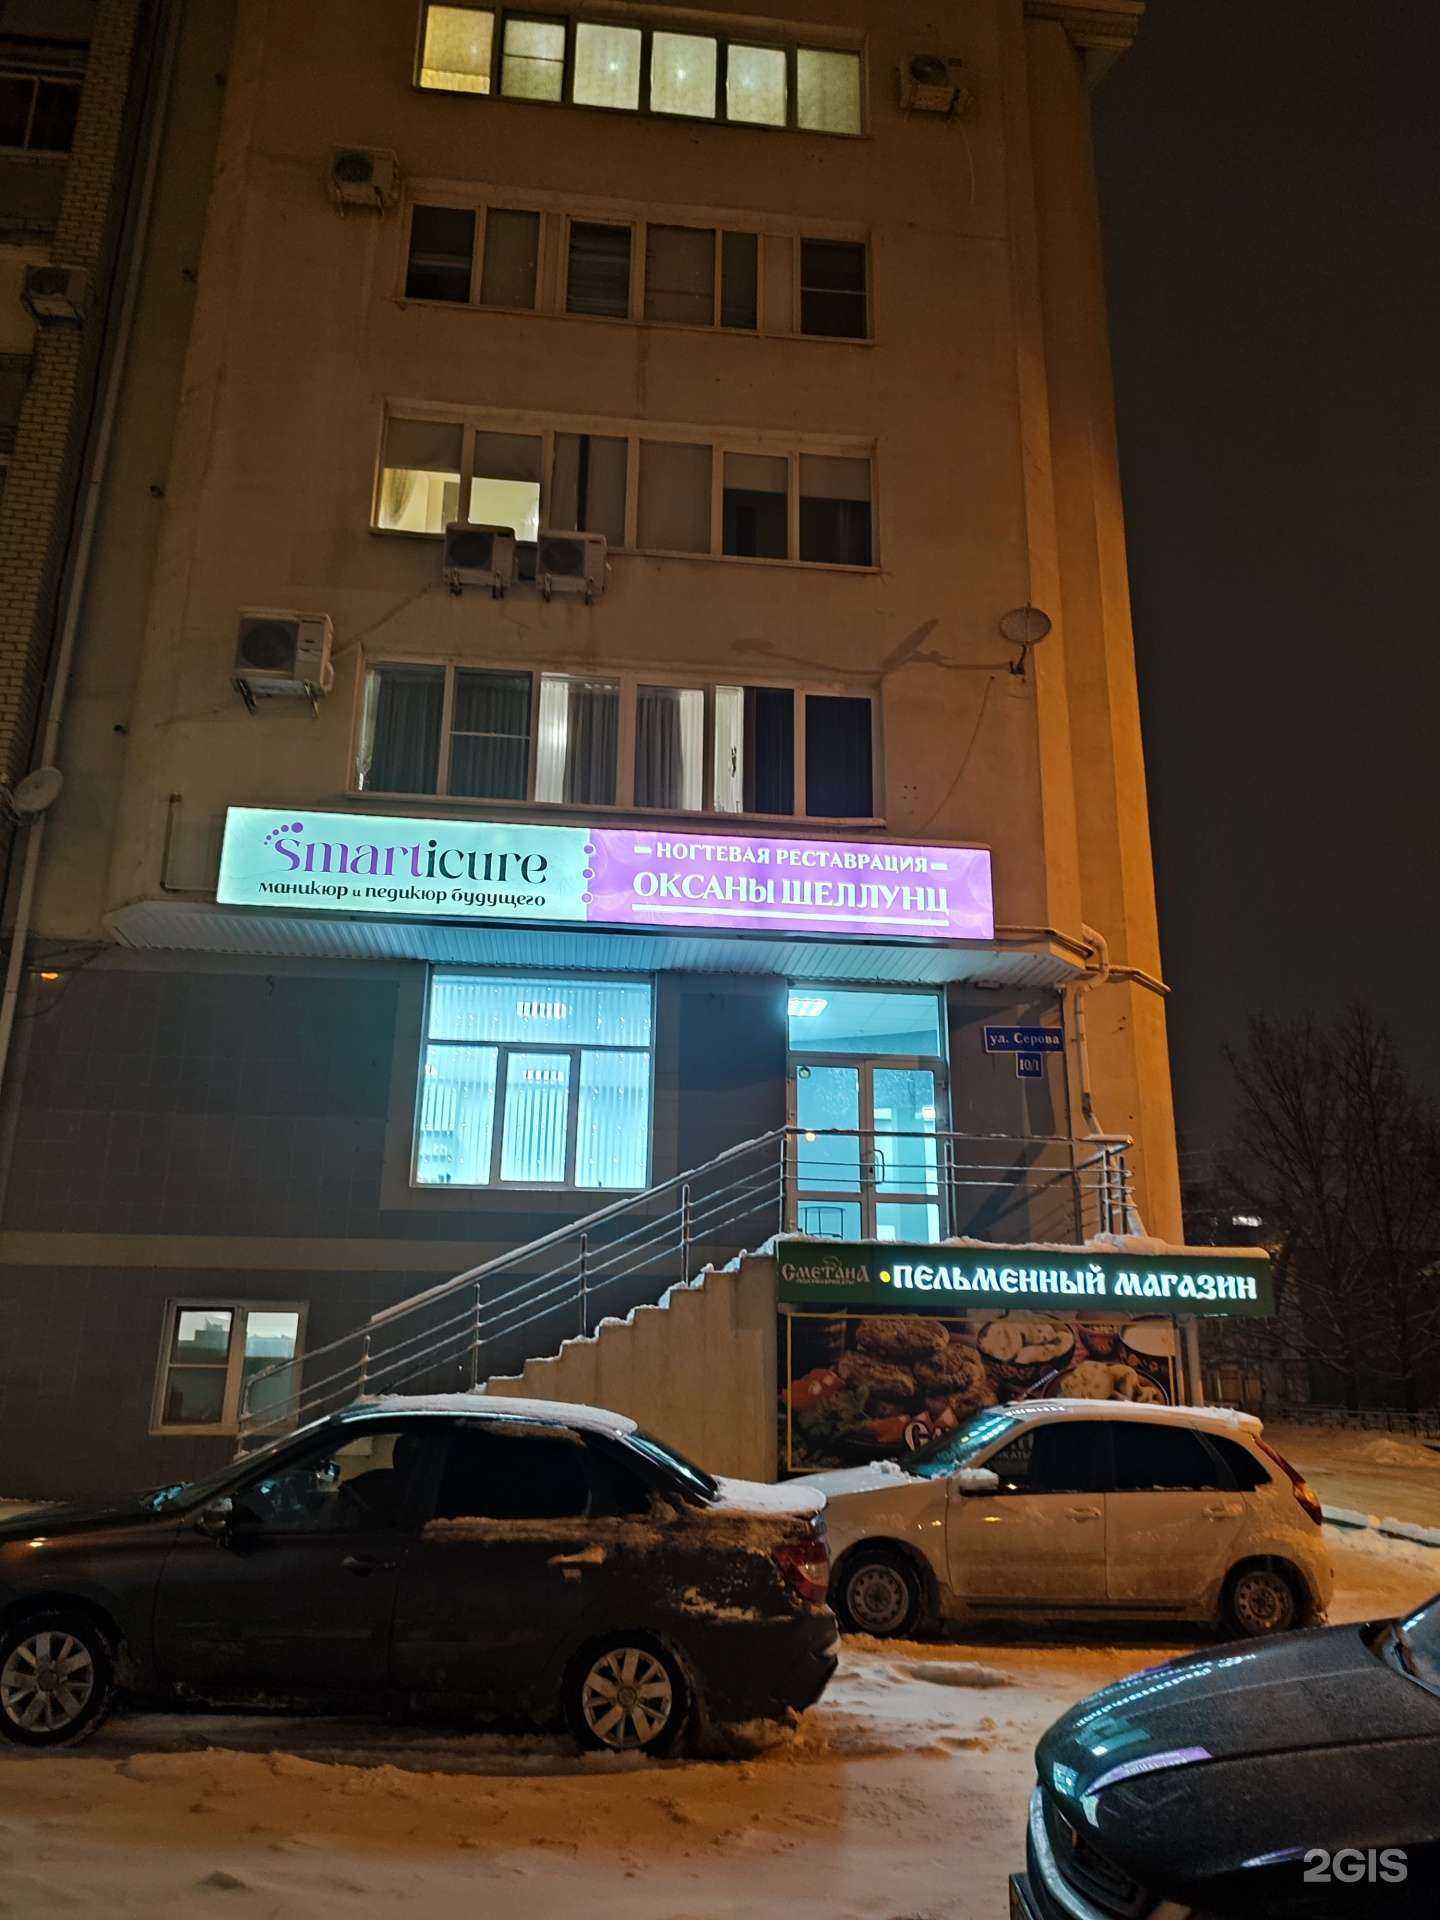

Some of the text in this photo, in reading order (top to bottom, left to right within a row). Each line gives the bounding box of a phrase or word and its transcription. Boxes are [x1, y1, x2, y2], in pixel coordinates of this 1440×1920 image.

[656, 842, 928, 874] НОГТЕВАЯ РЕСТАВРАЦИЯ
[258, 880, 546, 910] маникюр и педикюр будущего
[633, 871, 950, 916] ОКСАНЫ ШЕЛЛУНЦ
[1013, 1032, 1060, 1046] Серова
[893, 1264, 1257, 1301] ПЕЛЬМЕННЫЙ МАГАЗИН
